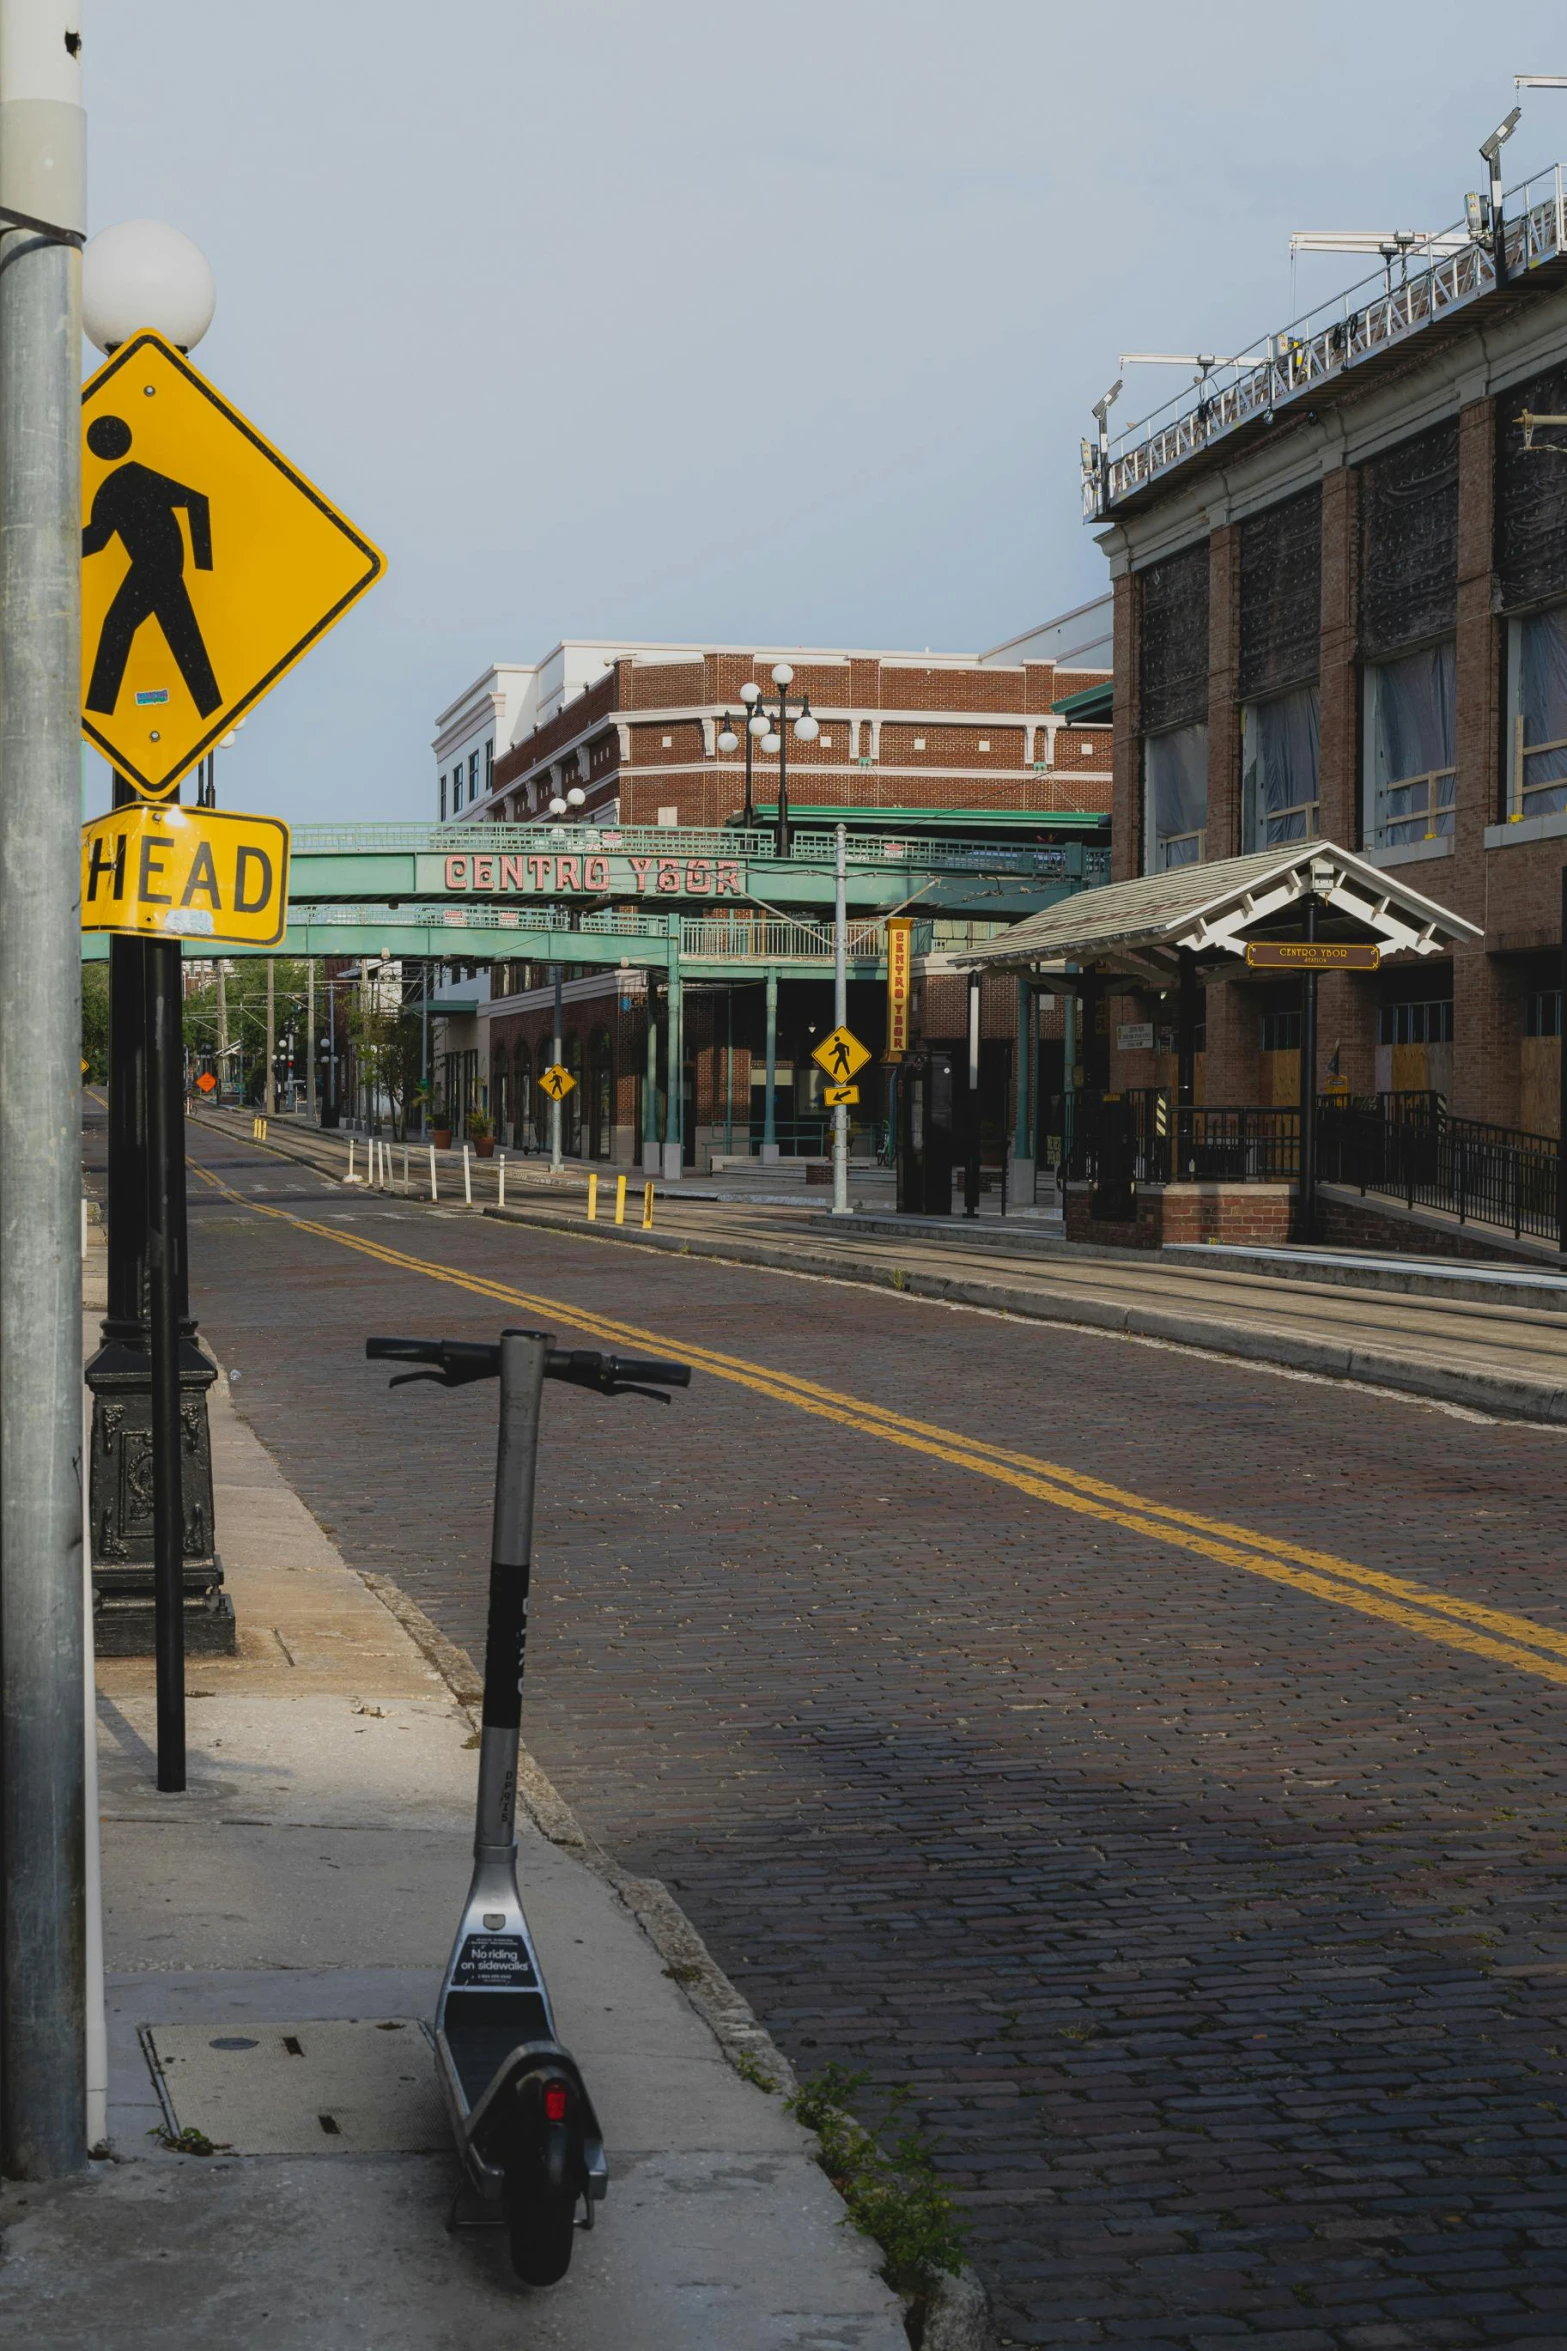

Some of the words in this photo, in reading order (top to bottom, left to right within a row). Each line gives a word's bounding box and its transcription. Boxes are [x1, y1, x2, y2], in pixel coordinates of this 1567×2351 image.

[87, 835, 272, 913] HEAD
[445, 855, 610, 891] CENTRO
[628, 857, 742, 895] YBOR
[895, 931, 905, 999] CENTRO
[1279, 947, 1317, 957] CENTRO
[1321, 948, 1348, 958] YBOR
[893, 1004, 904, 1049] YBOR
[461, 1962, 474, 1970] on
[478, 1960, 528, 1971] sidewalks
[472, 1949, 487, 1959] No
[489, 1949, 517, 1961] riding
